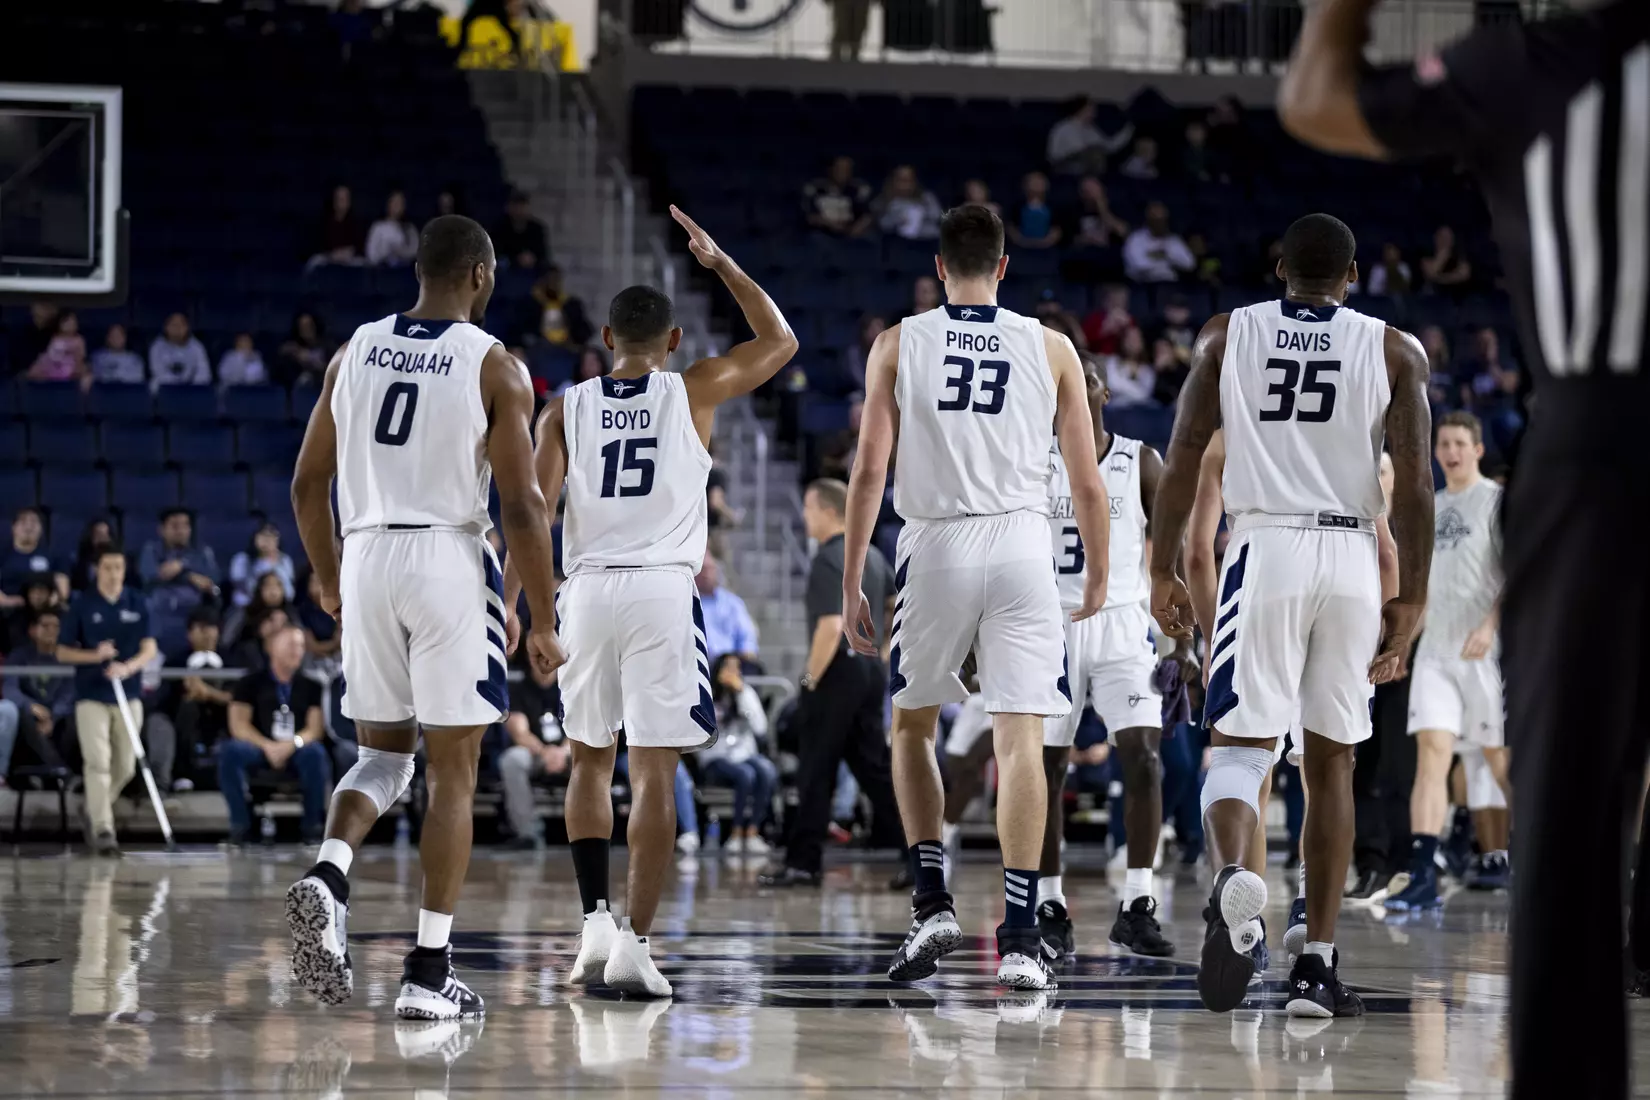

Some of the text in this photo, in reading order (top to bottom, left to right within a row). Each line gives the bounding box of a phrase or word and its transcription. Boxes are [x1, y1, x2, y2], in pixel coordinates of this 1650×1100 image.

[364, 345, 454, 376] ACQUAAH
[946, 330, 1000, 353] PIROG
[1275, 329, 1331, 352] DAVIS
[937, 354, 1011, 415] 33
[1259, 358, 1342, 423] 35
[374, 381, 419, 447] 0
[602, 409, 651, 431] BOYD
[600, 437, 658, 498] 15
